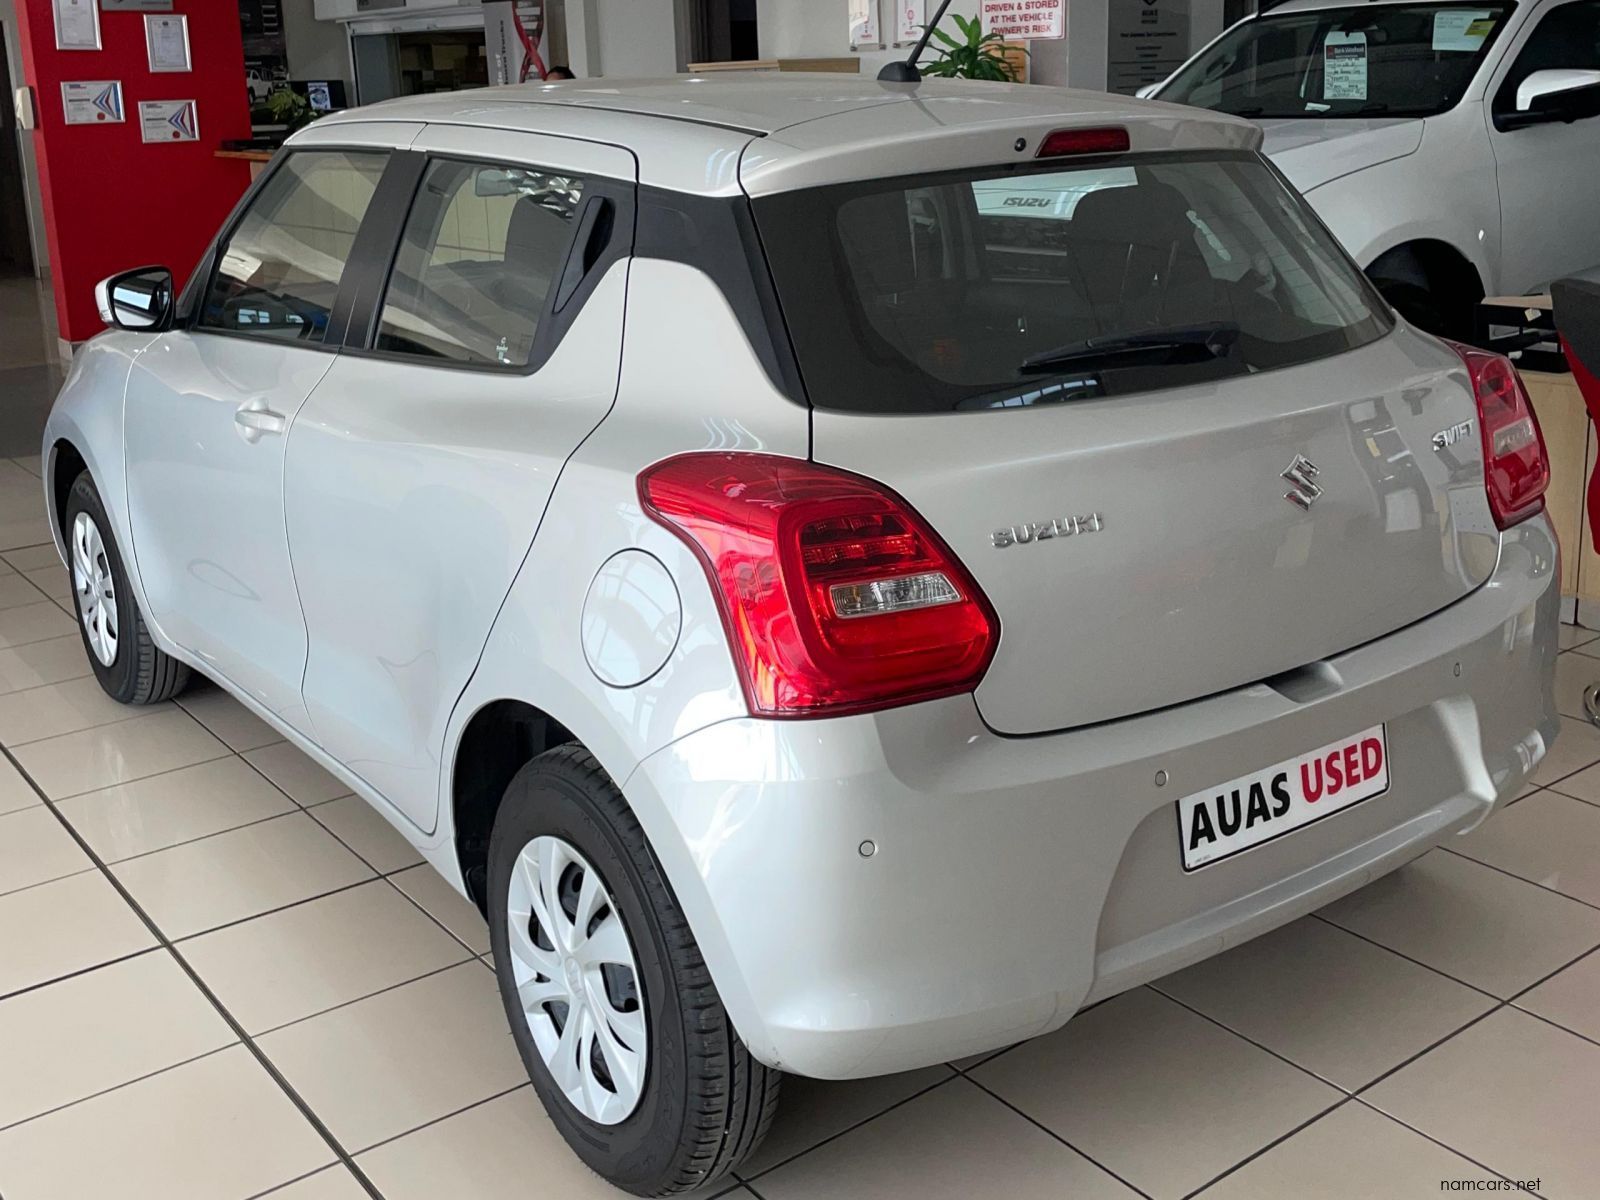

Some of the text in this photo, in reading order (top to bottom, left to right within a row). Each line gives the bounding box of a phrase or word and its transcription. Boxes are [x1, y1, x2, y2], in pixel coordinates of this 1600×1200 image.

[985, 0, 1059, 13] DRIVEN & STORED
[990, 12, 1053, 24] AT THE VEHICLE
[991, 24, 1052, 35] OWNER'S RISK
[1002, 197, 1051, 208] ISUZU
[1432, 418, 1474, 452] SWIFT
[991, 512, 1104, 549] SUZUKI
[1189, 737, 1383, 851] AUAS USED
